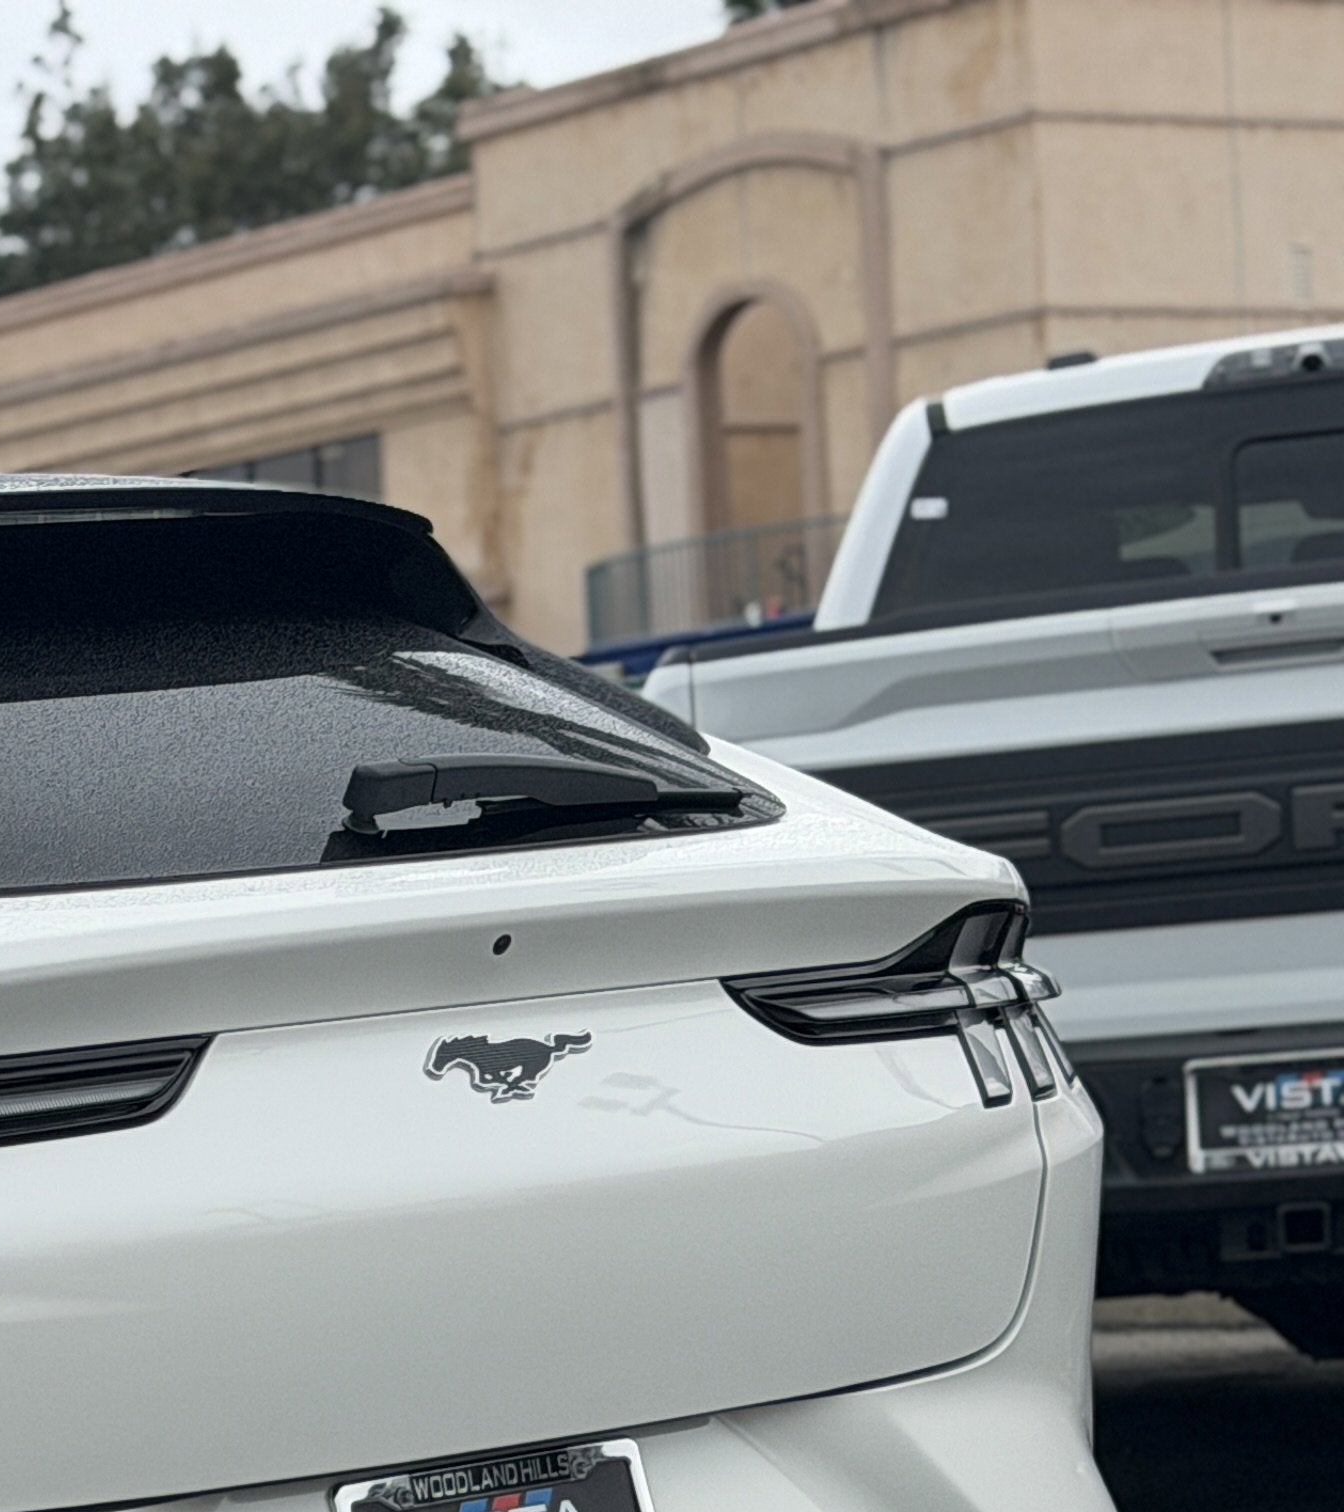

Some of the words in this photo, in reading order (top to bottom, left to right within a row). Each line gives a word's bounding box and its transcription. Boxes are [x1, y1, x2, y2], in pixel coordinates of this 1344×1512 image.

[1229, 1078, 1344, 1114] VIST
[412, 1460, 519, 1501] WOODLAND
[520, 1453, 570, 1482] HILLS
